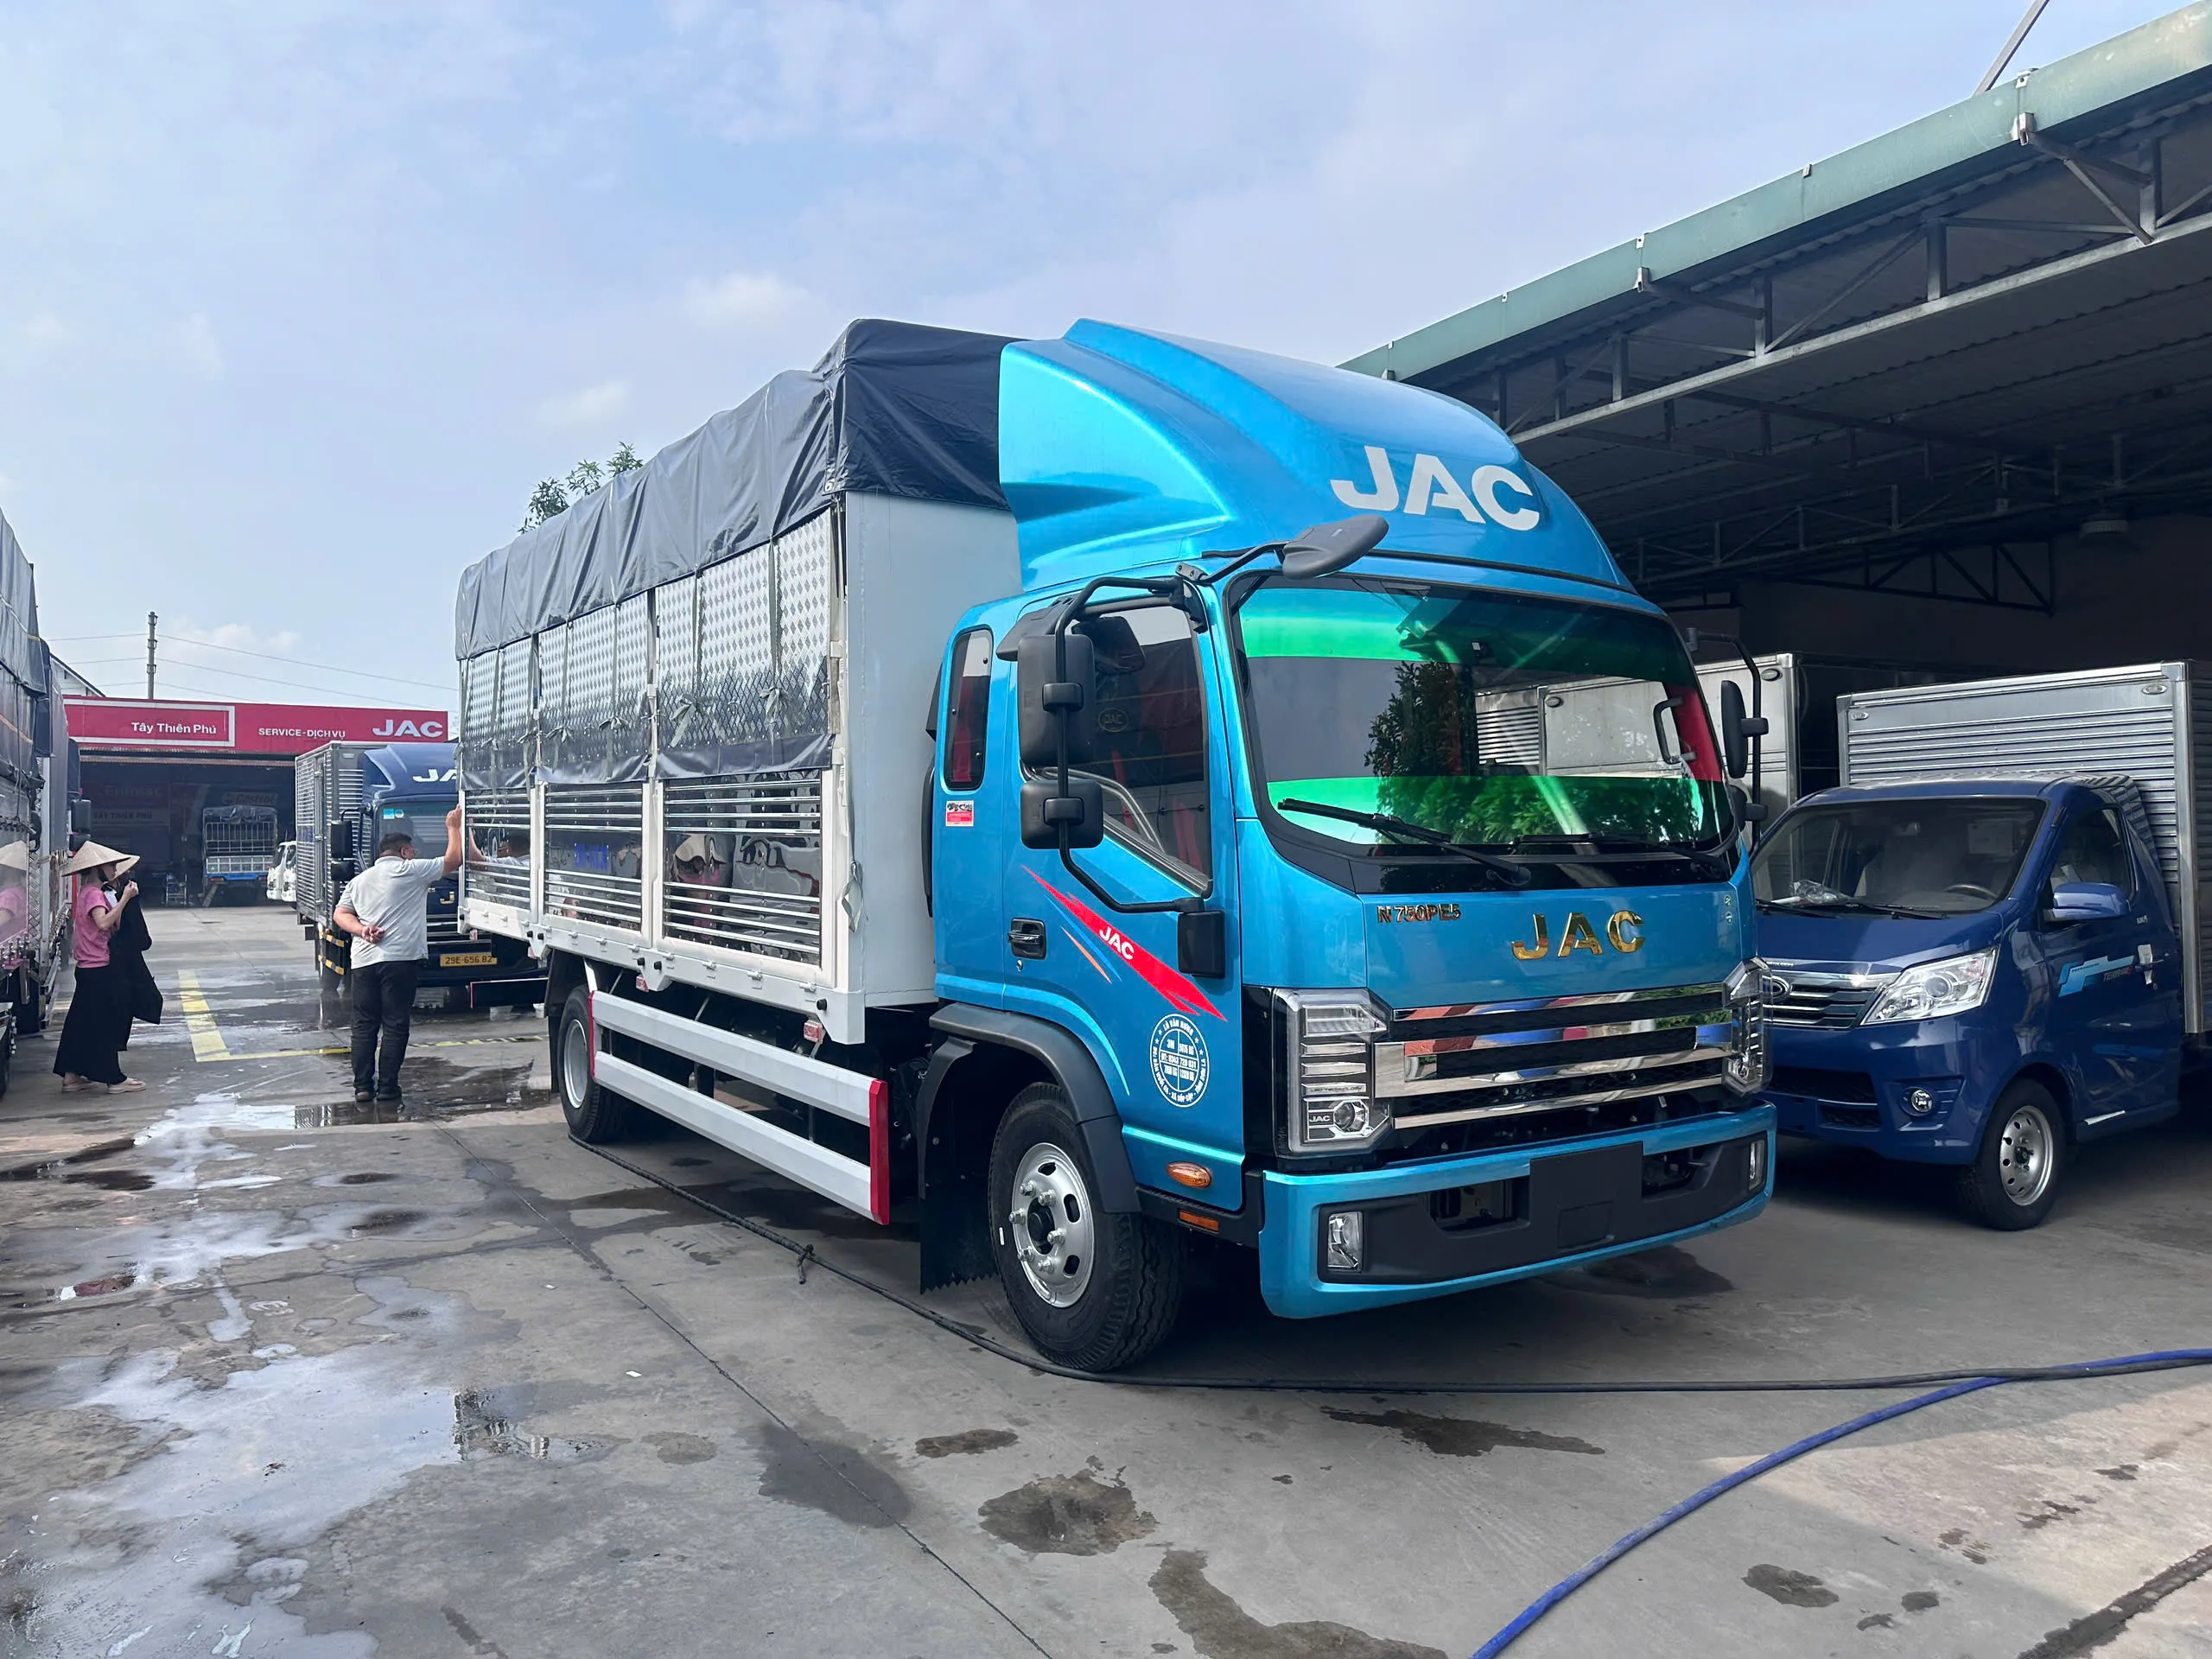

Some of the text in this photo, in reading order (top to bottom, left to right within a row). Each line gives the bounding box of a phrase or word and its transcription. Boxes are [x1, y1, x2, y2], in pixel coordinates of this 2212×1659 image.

[1330, 445, 1540, 531] JAC
[131, 721, 154, 734] Tây
[156, 723, 191, 733] Thiên
[372, 719, 443, 738] JAC
[413, 769, 457, 782] JA
[1099, 926, 1134, 960] JAC
[1512, 909, 1646, 961] JAC
